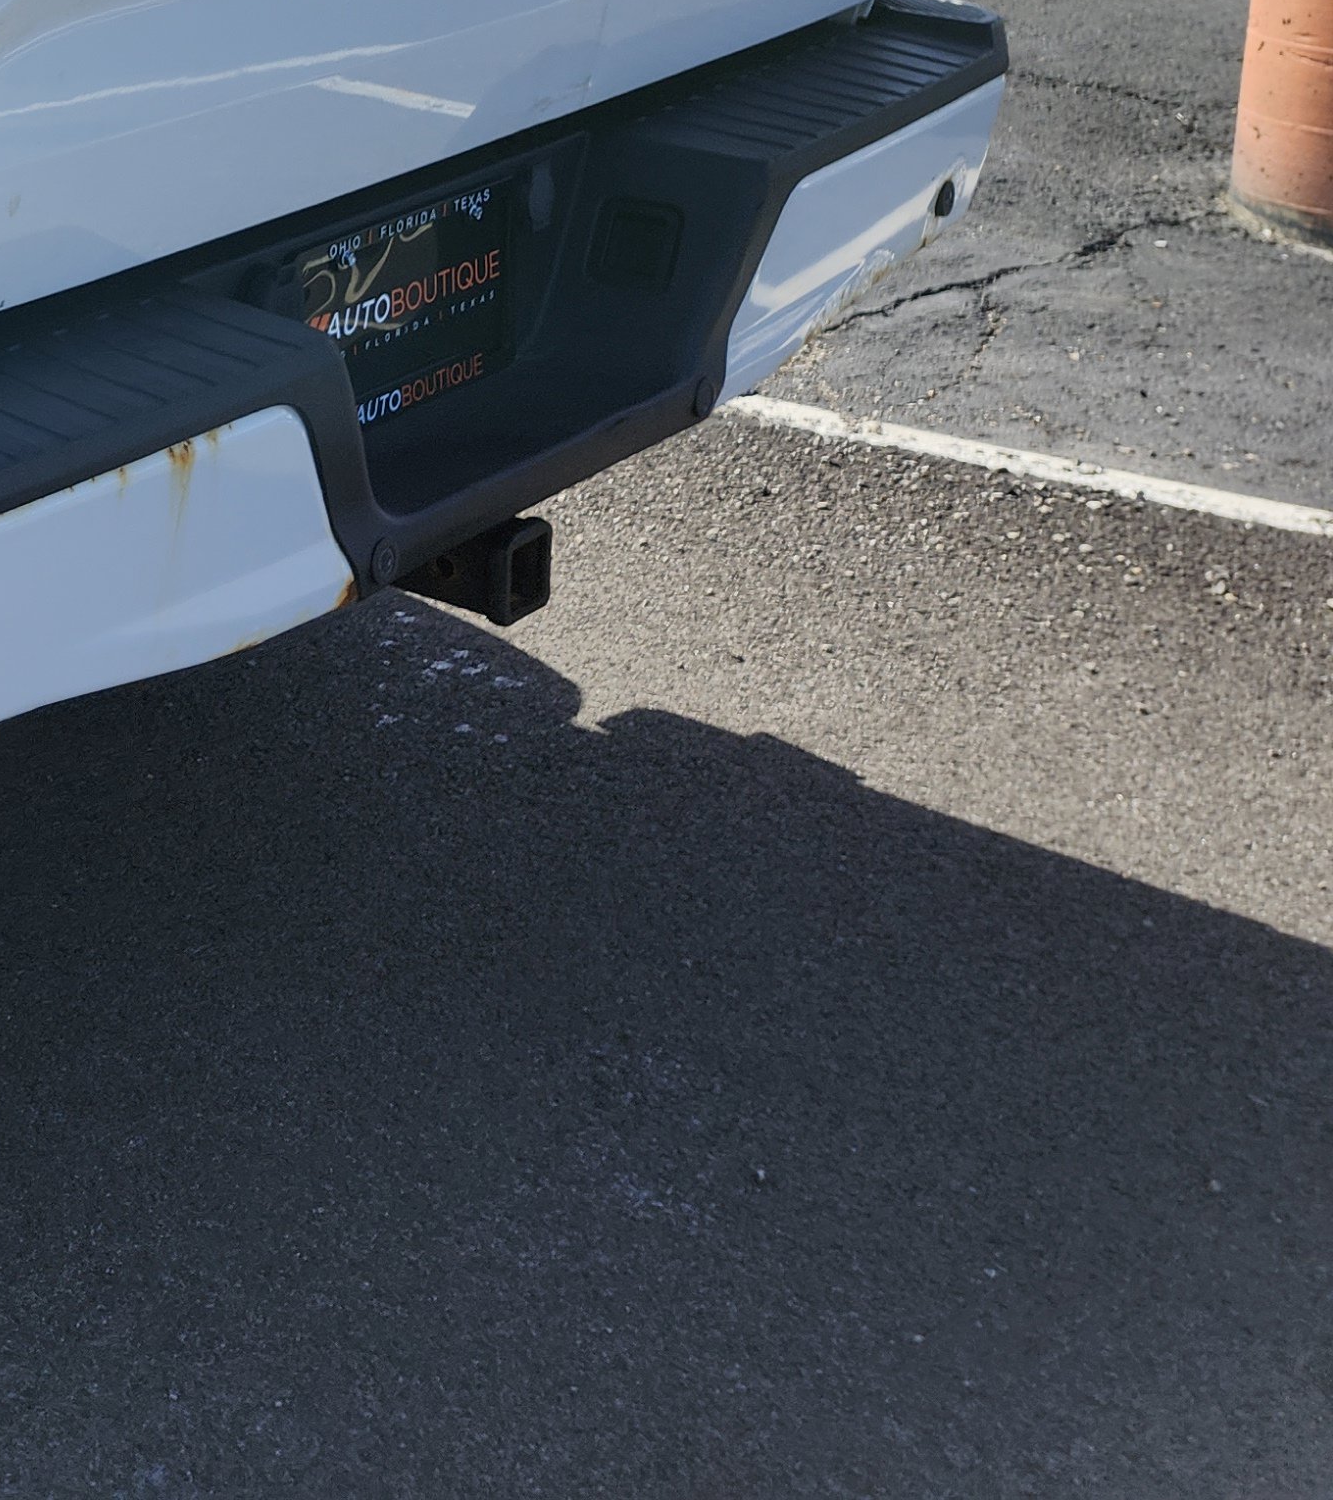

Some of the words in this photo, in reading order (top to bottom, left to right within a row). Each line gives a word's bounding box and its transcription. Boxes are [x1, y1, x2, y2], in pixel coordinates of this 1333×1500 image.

[329, 234, 361, 259] OHIO
[379, 208, 437, 239] FLORIDA
[454, 188, 491, 212] TEXAS
[364, 317, 430, 350] FLORIDA
[450, 289, 495, 315] TEXAS
